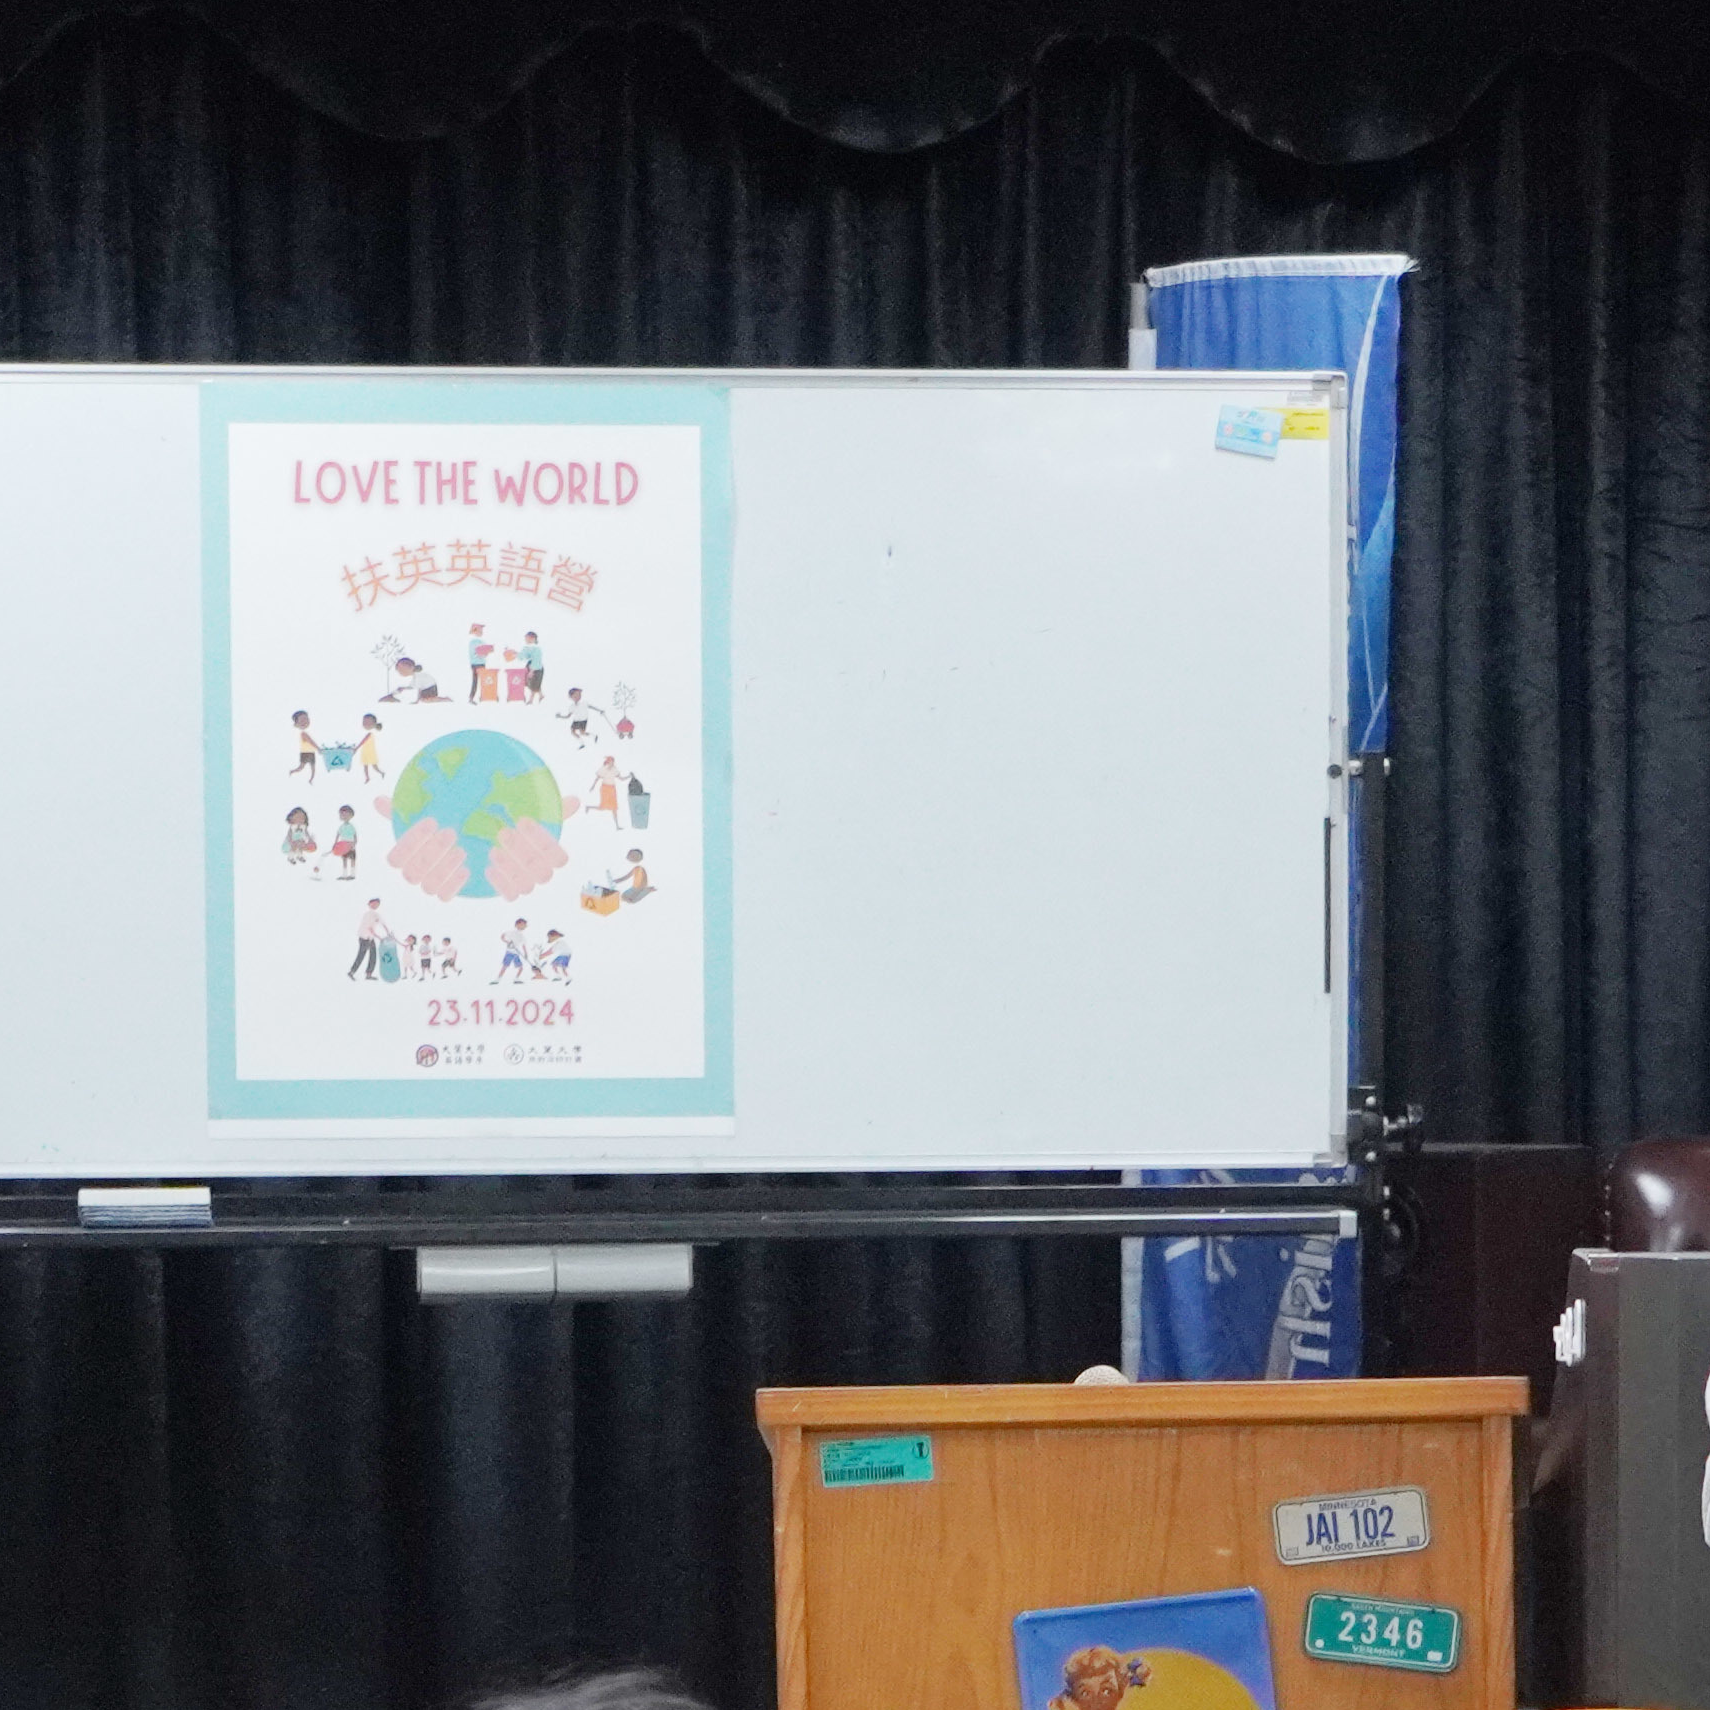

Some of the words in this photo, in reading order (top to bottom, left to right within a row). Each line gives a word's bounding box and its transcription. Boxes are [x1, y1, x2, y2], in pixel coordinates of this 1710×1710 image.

[293, 460, 399, 505] LOVE
[413, 460, 479, 505] THE
[493, 460, 640, 507] WORLD
[340, 538, 598, 613] 扶英英語營
[427, 999, 575, 1027] 23.11.2024
[1306, 1510, 1340, 1546] JAI
[1349, 1505, 1396, 1542] 102
[1337, 1610, 1424, 1650] 2346
